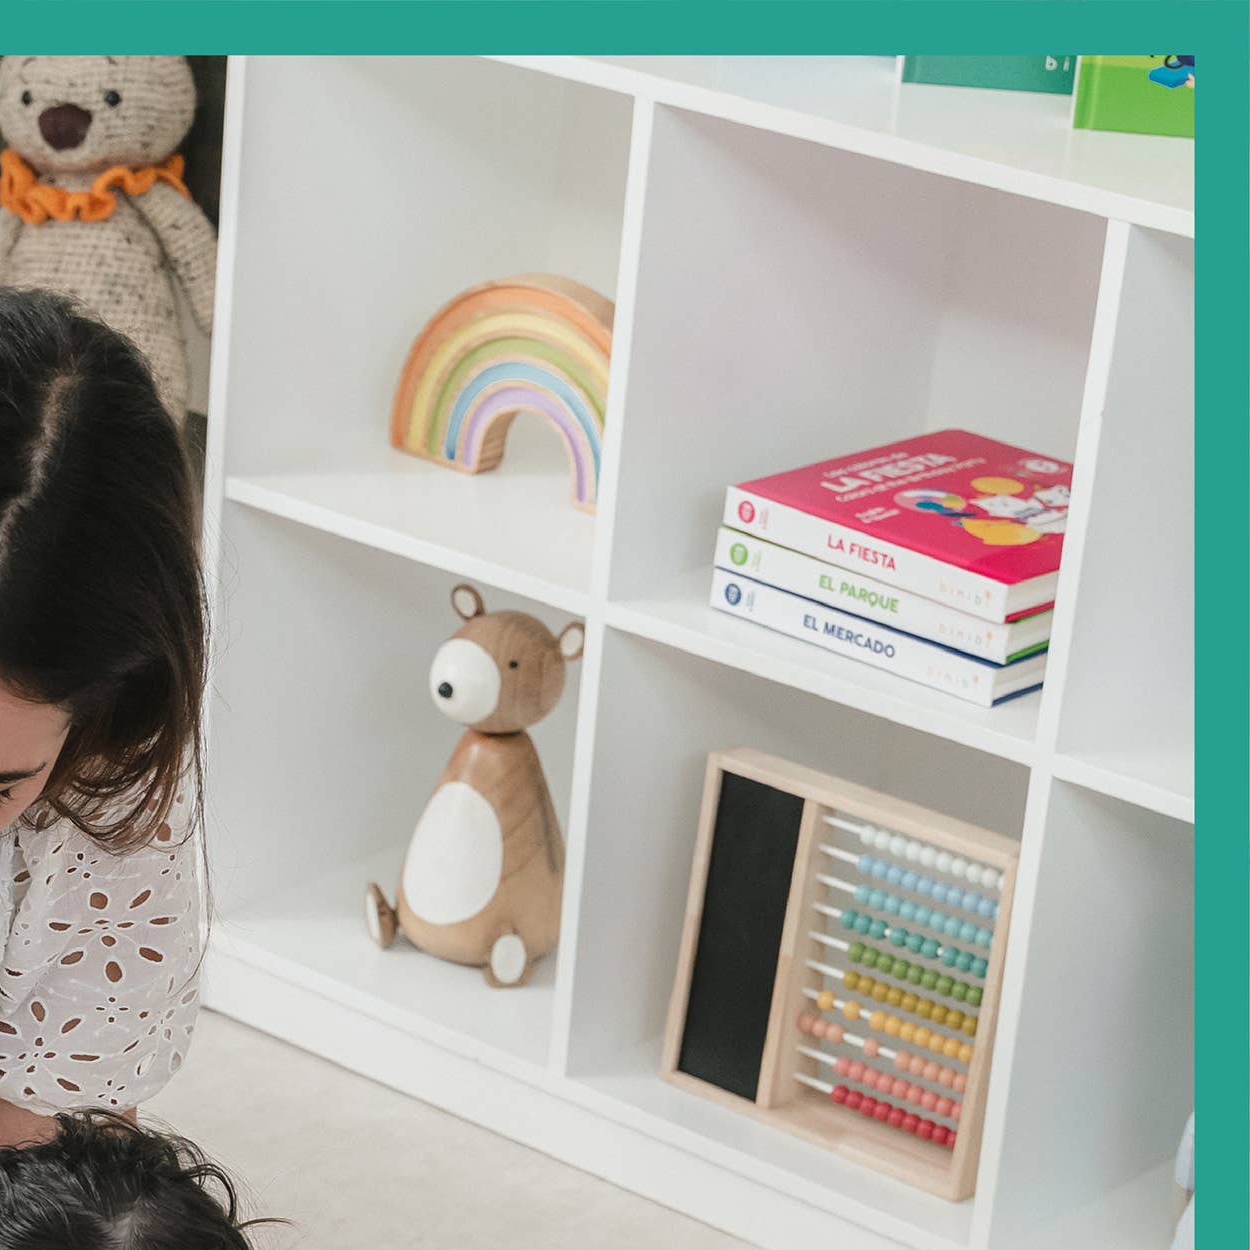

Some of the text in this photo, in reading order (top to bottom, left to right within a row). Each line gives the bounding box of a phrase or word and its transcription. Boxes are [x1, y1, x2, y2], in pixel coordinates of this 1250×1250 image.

[820, 477, 870, 492] LA
[859, 453, 957, 482] FIESTA
[827, 533, 896, 570] LA FIESTA
[819, 574, 899, 613] EL PARQUE
[803, 614, 895, 658] EL MERCADO
